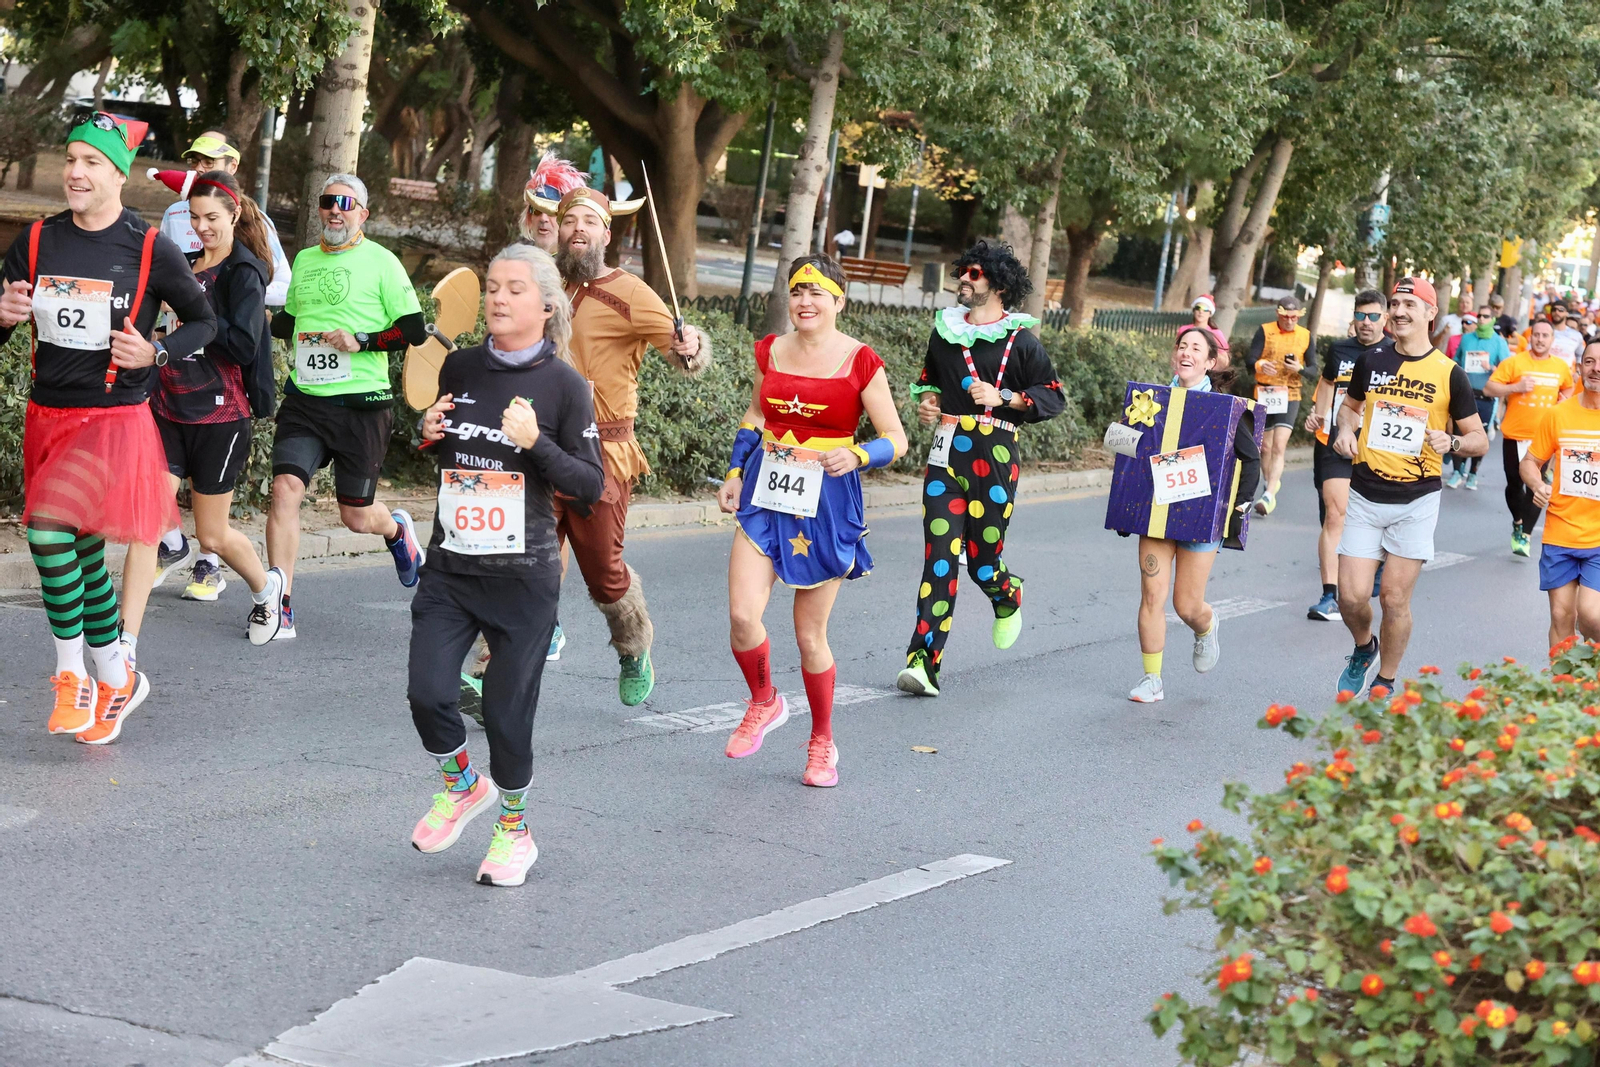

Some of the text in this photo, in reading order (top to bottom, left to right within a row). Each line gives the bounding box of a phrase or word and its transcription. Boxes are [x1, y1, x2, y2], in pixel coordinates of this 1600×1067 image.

[57, 308, 86, 329] 62
[306, 353, 339, 370] 438
[1369, 370, 1436, 394] bichos
[1265, 397, 1282, 406] 593
[1368, 384, 1434, 404] runners
[1381, 422, 1413, 441] 322
[455, 452, 504, 471] PRIMOR
[768, 471, 805, 496] 844
[1166, 469, 1198, 489] 518
[1572, 469, 1599, 486] 806
[455, 506, 505, 531] 630
